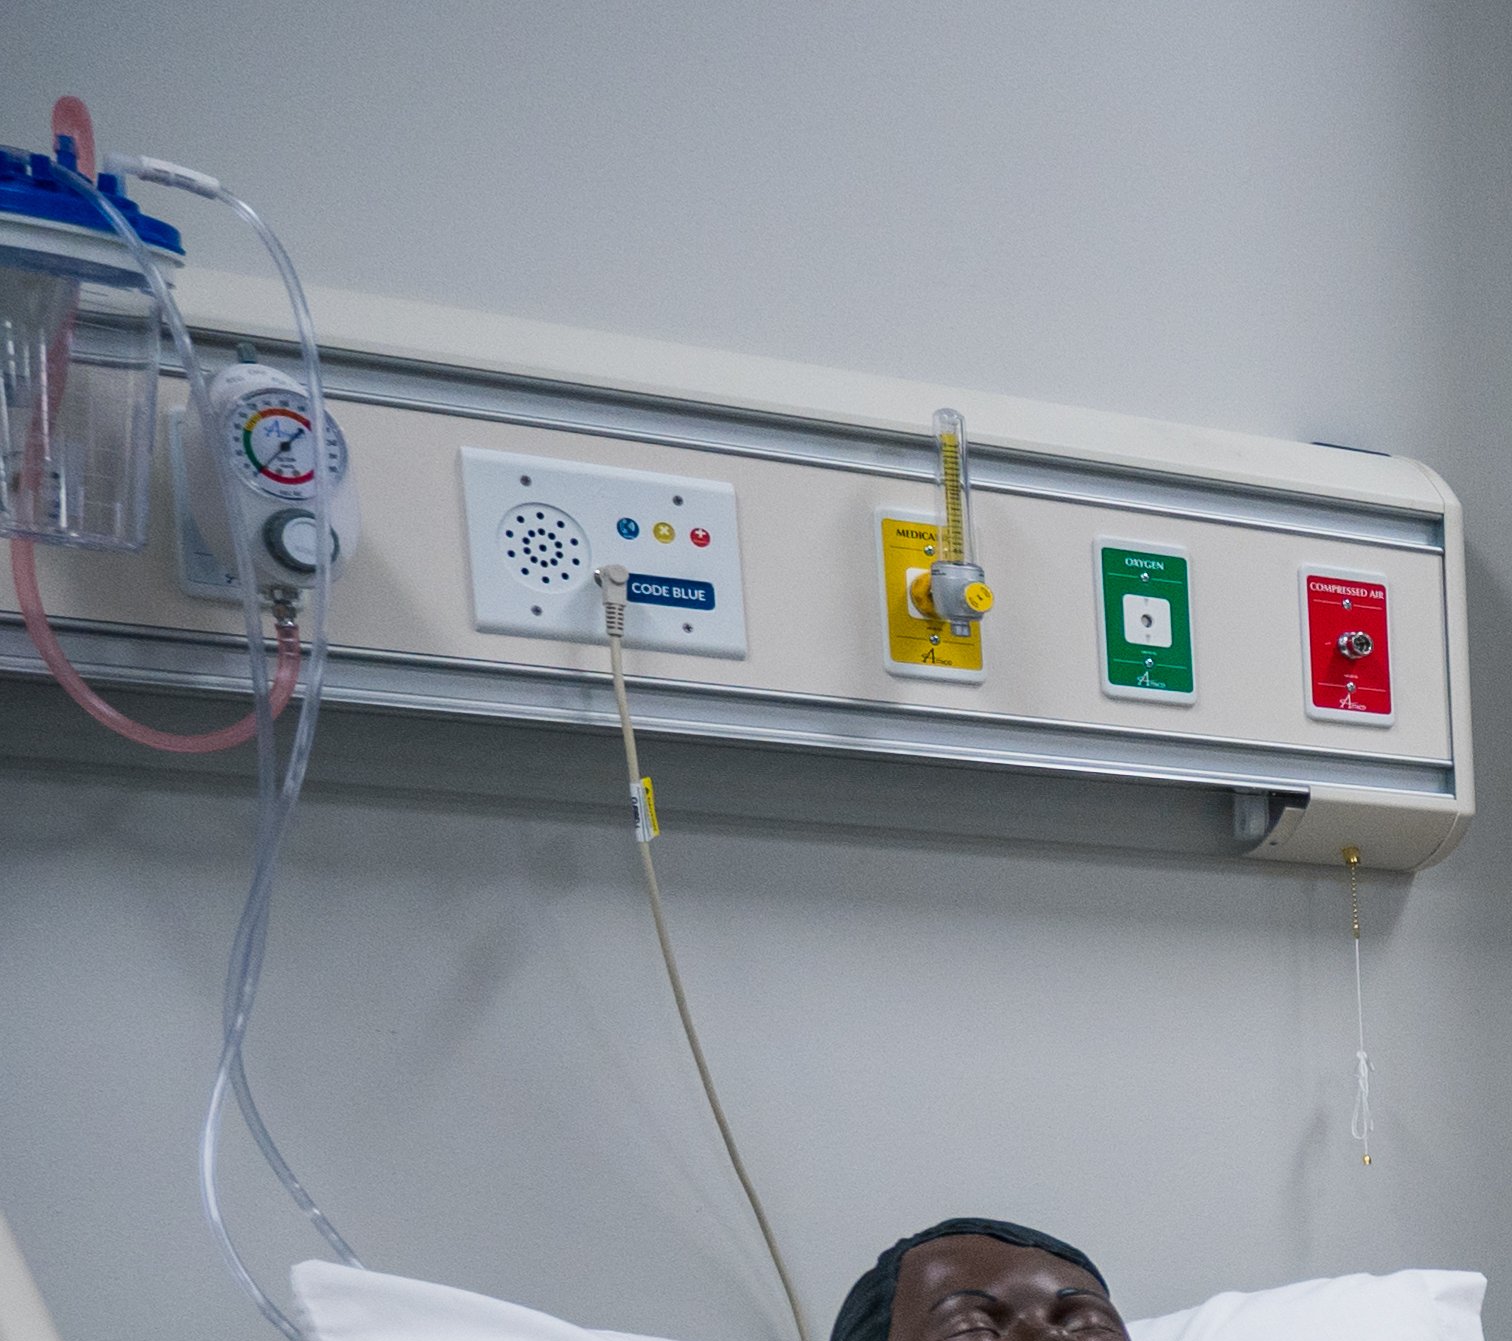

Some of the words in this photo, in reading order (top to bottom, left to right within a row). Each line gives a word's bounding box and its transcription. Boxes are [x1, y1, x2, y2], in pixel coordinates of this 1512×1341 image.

[1124, 557, 1164, 570] OXYGEN
[631, 582, 669, 597] CODE
[672, 588, 706, 601] BLUE
[1310, 581, 1367, 597] COMPRESSED
[1369, 590, 1384, 599] AIR
